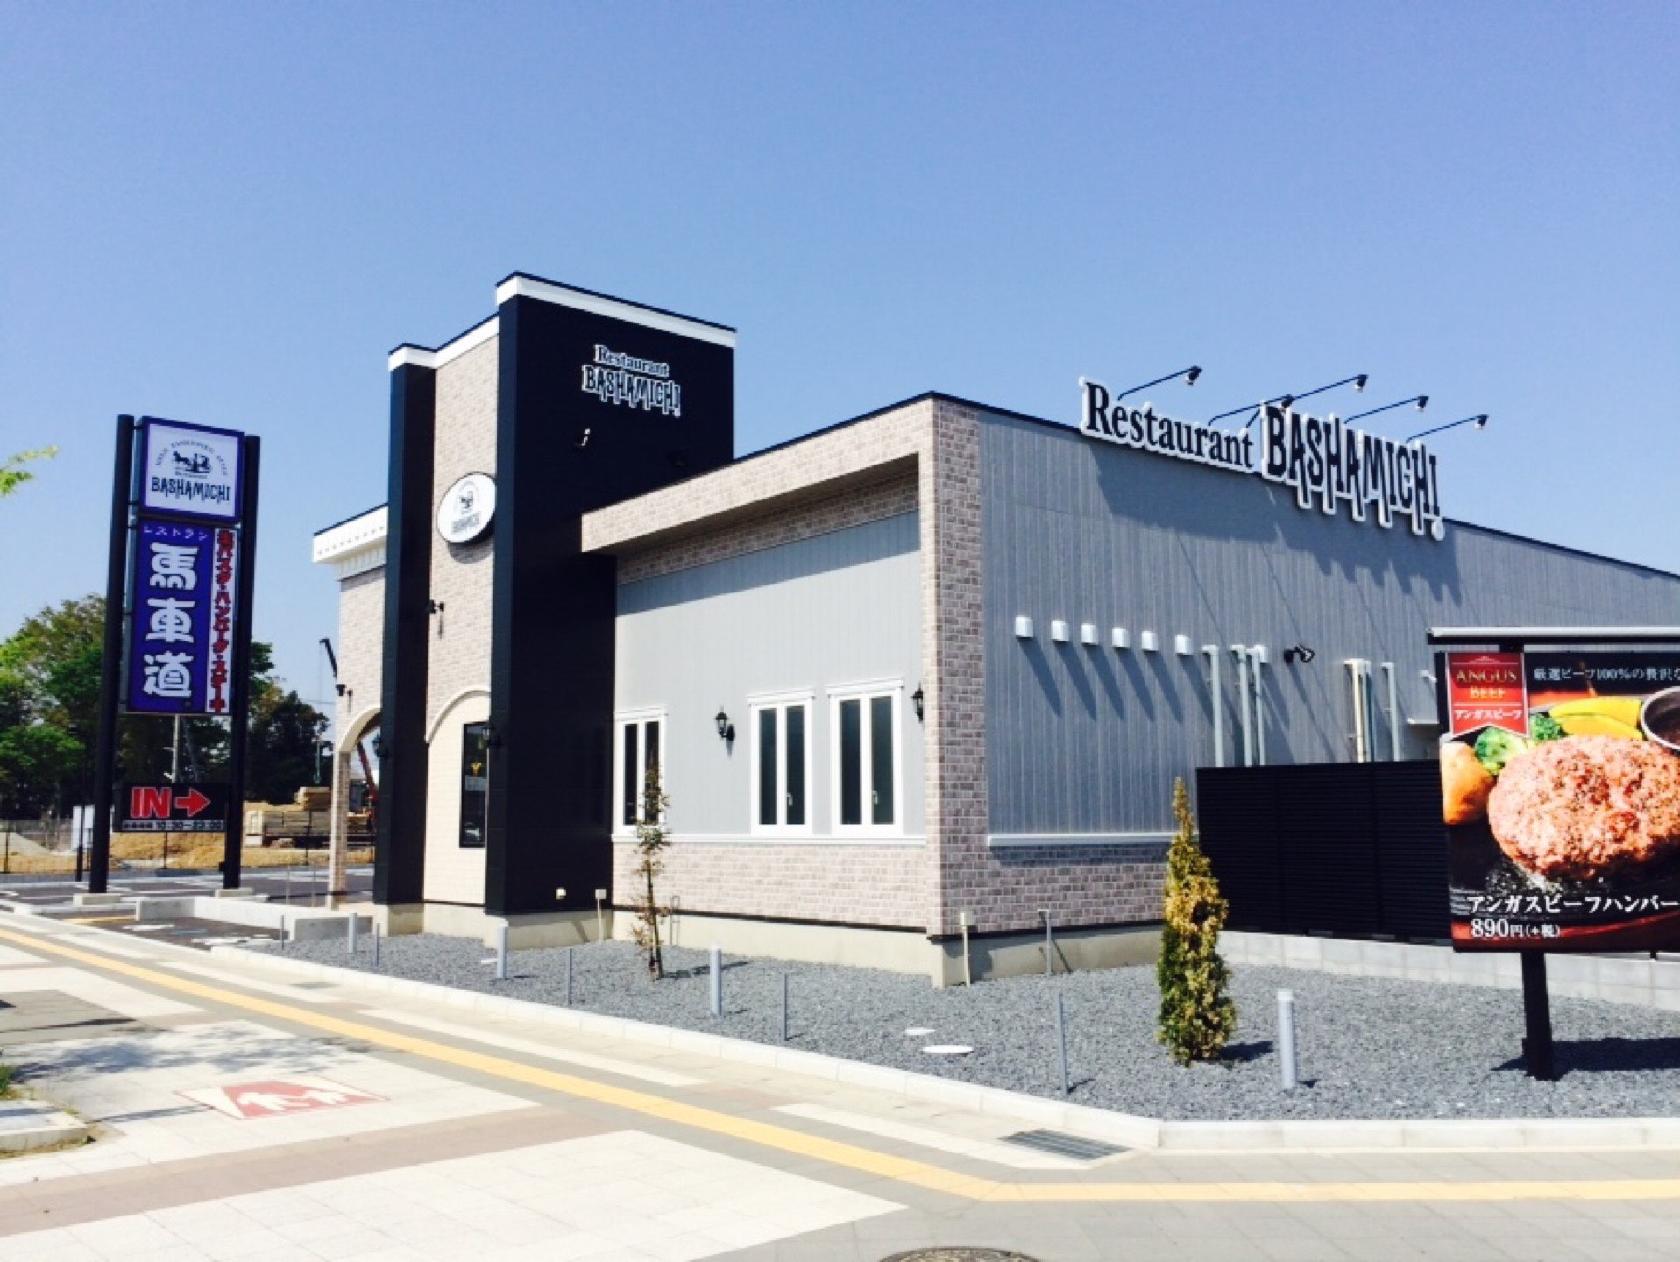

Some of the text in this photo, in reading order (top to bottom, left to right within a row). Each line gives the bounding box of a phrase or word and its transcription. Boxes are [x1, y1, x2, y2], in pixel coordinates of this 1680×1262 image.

[593, 344, 670, 378] Restaurant
[581, 365, 681, 417] BASHAMICHI
[1080, 377, 1254, 474] Restaurant
[1260, 400, 1444, 541] BASHAMICHI
[151, 476, 231, 505] BASHAMICHI
[143, 525, 209, 541] レストラン
[142, 541, 199, 698] 馬車道
[1456, 669, 1517, 683] ANGUS
[1455, 709, 1522, 721] アンガスビーフ
[130, 786, 172, 819] IN
[1467, 894, 1680, 914] アンガスビーフハンバー
